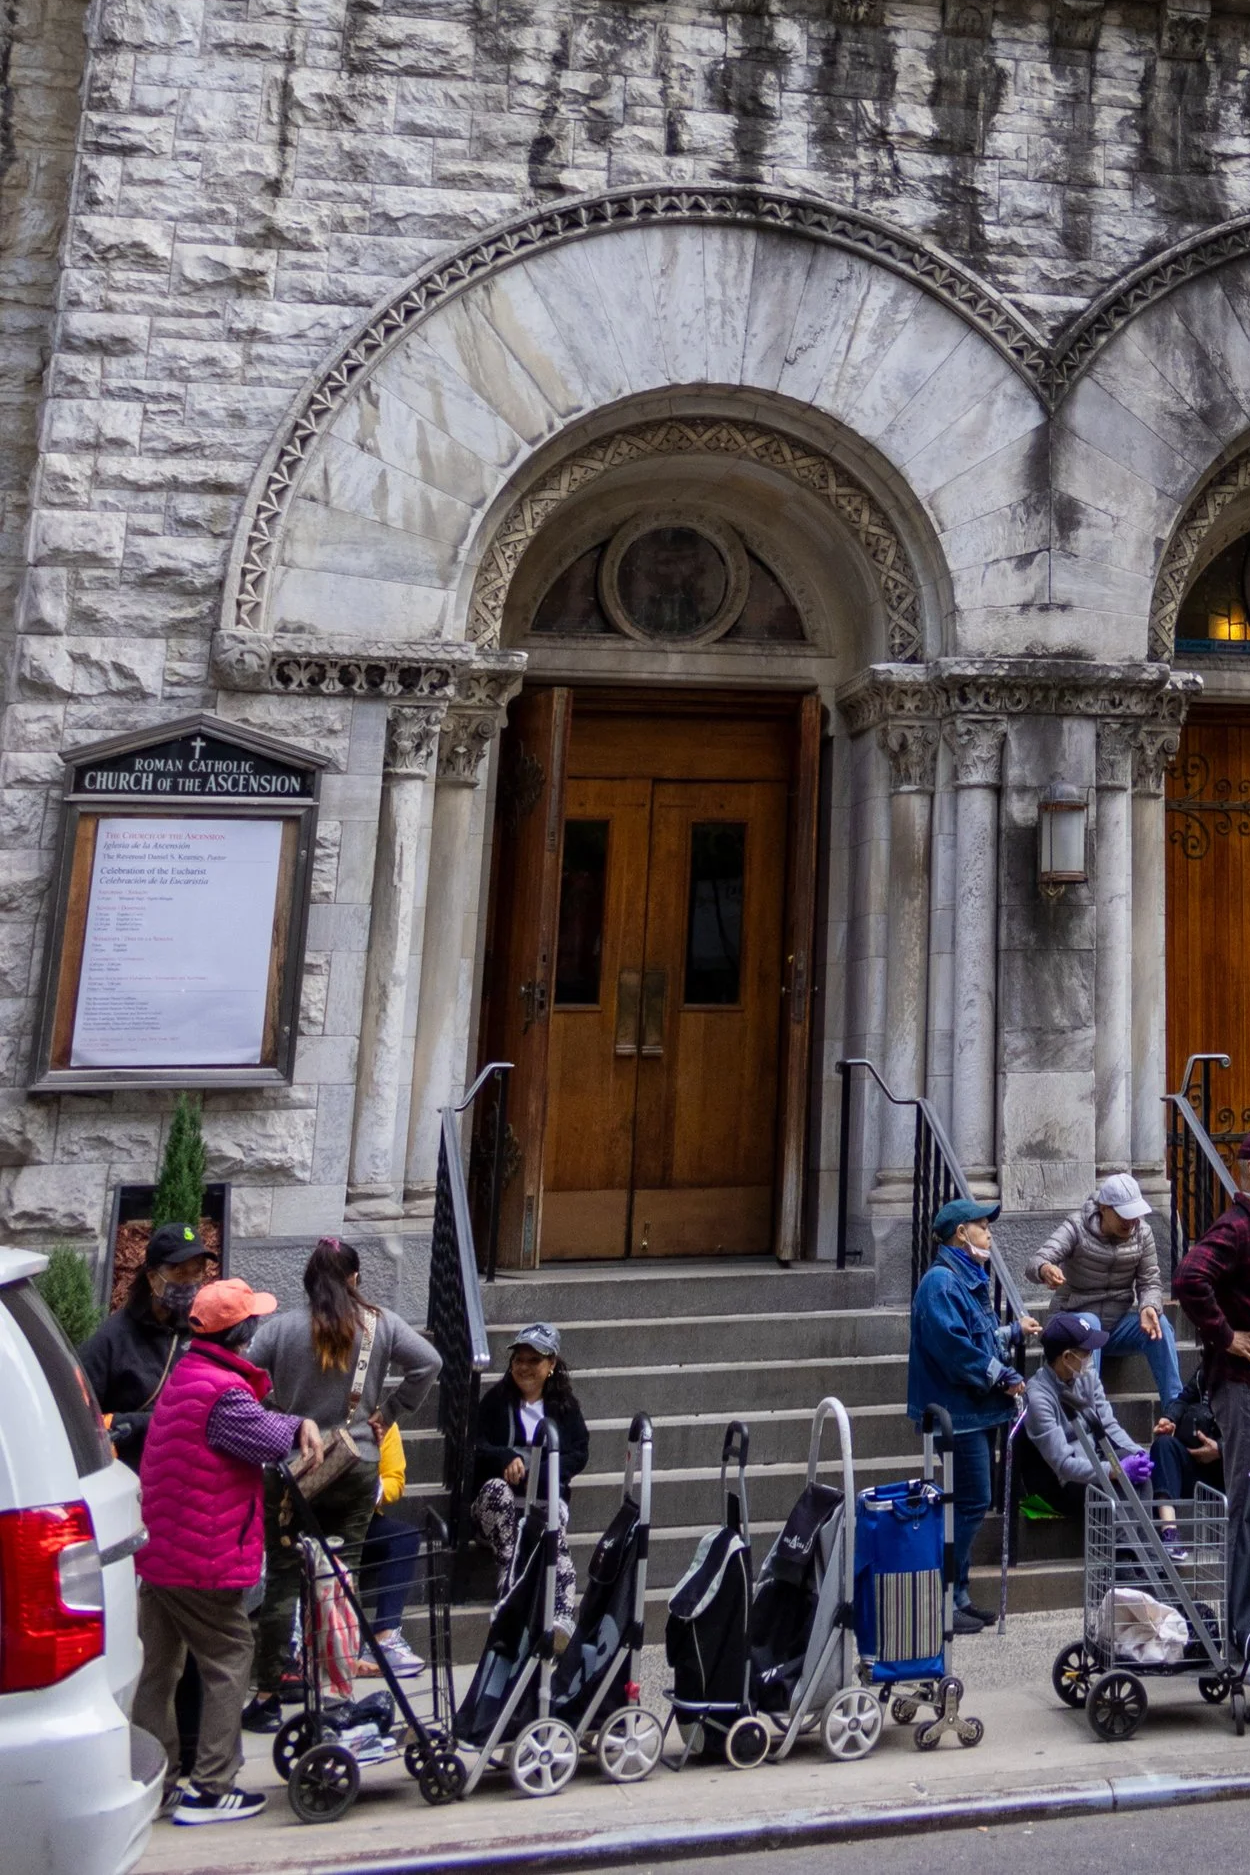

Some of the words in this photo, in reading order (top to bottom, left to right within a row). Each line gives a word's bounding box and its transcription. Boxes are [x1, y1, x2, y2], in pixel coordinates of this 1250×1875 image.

[135, 758, 183, 772] ROMAN
[188, 760, 254, 773] CATHOLIC
[84, 771, 153, 791] CHURCH
[157, 778, 173, 791] OF
[177, 778, 202, 792] THE
[205, 774, 301, 793] ASCENSION
[103, 841, 130, 851] Iglesia
[131, 841, 142, 849] de
[142, 841, 151, 849] la
[100, 867, 145, 875] Celebration
[146, 867, 156, 875] of
[157, 867, 169, 875] the
[171, 867, 207, 875] Eucharist
[149, 876, 158, 885] de
[159, 877, 168, 885] la
